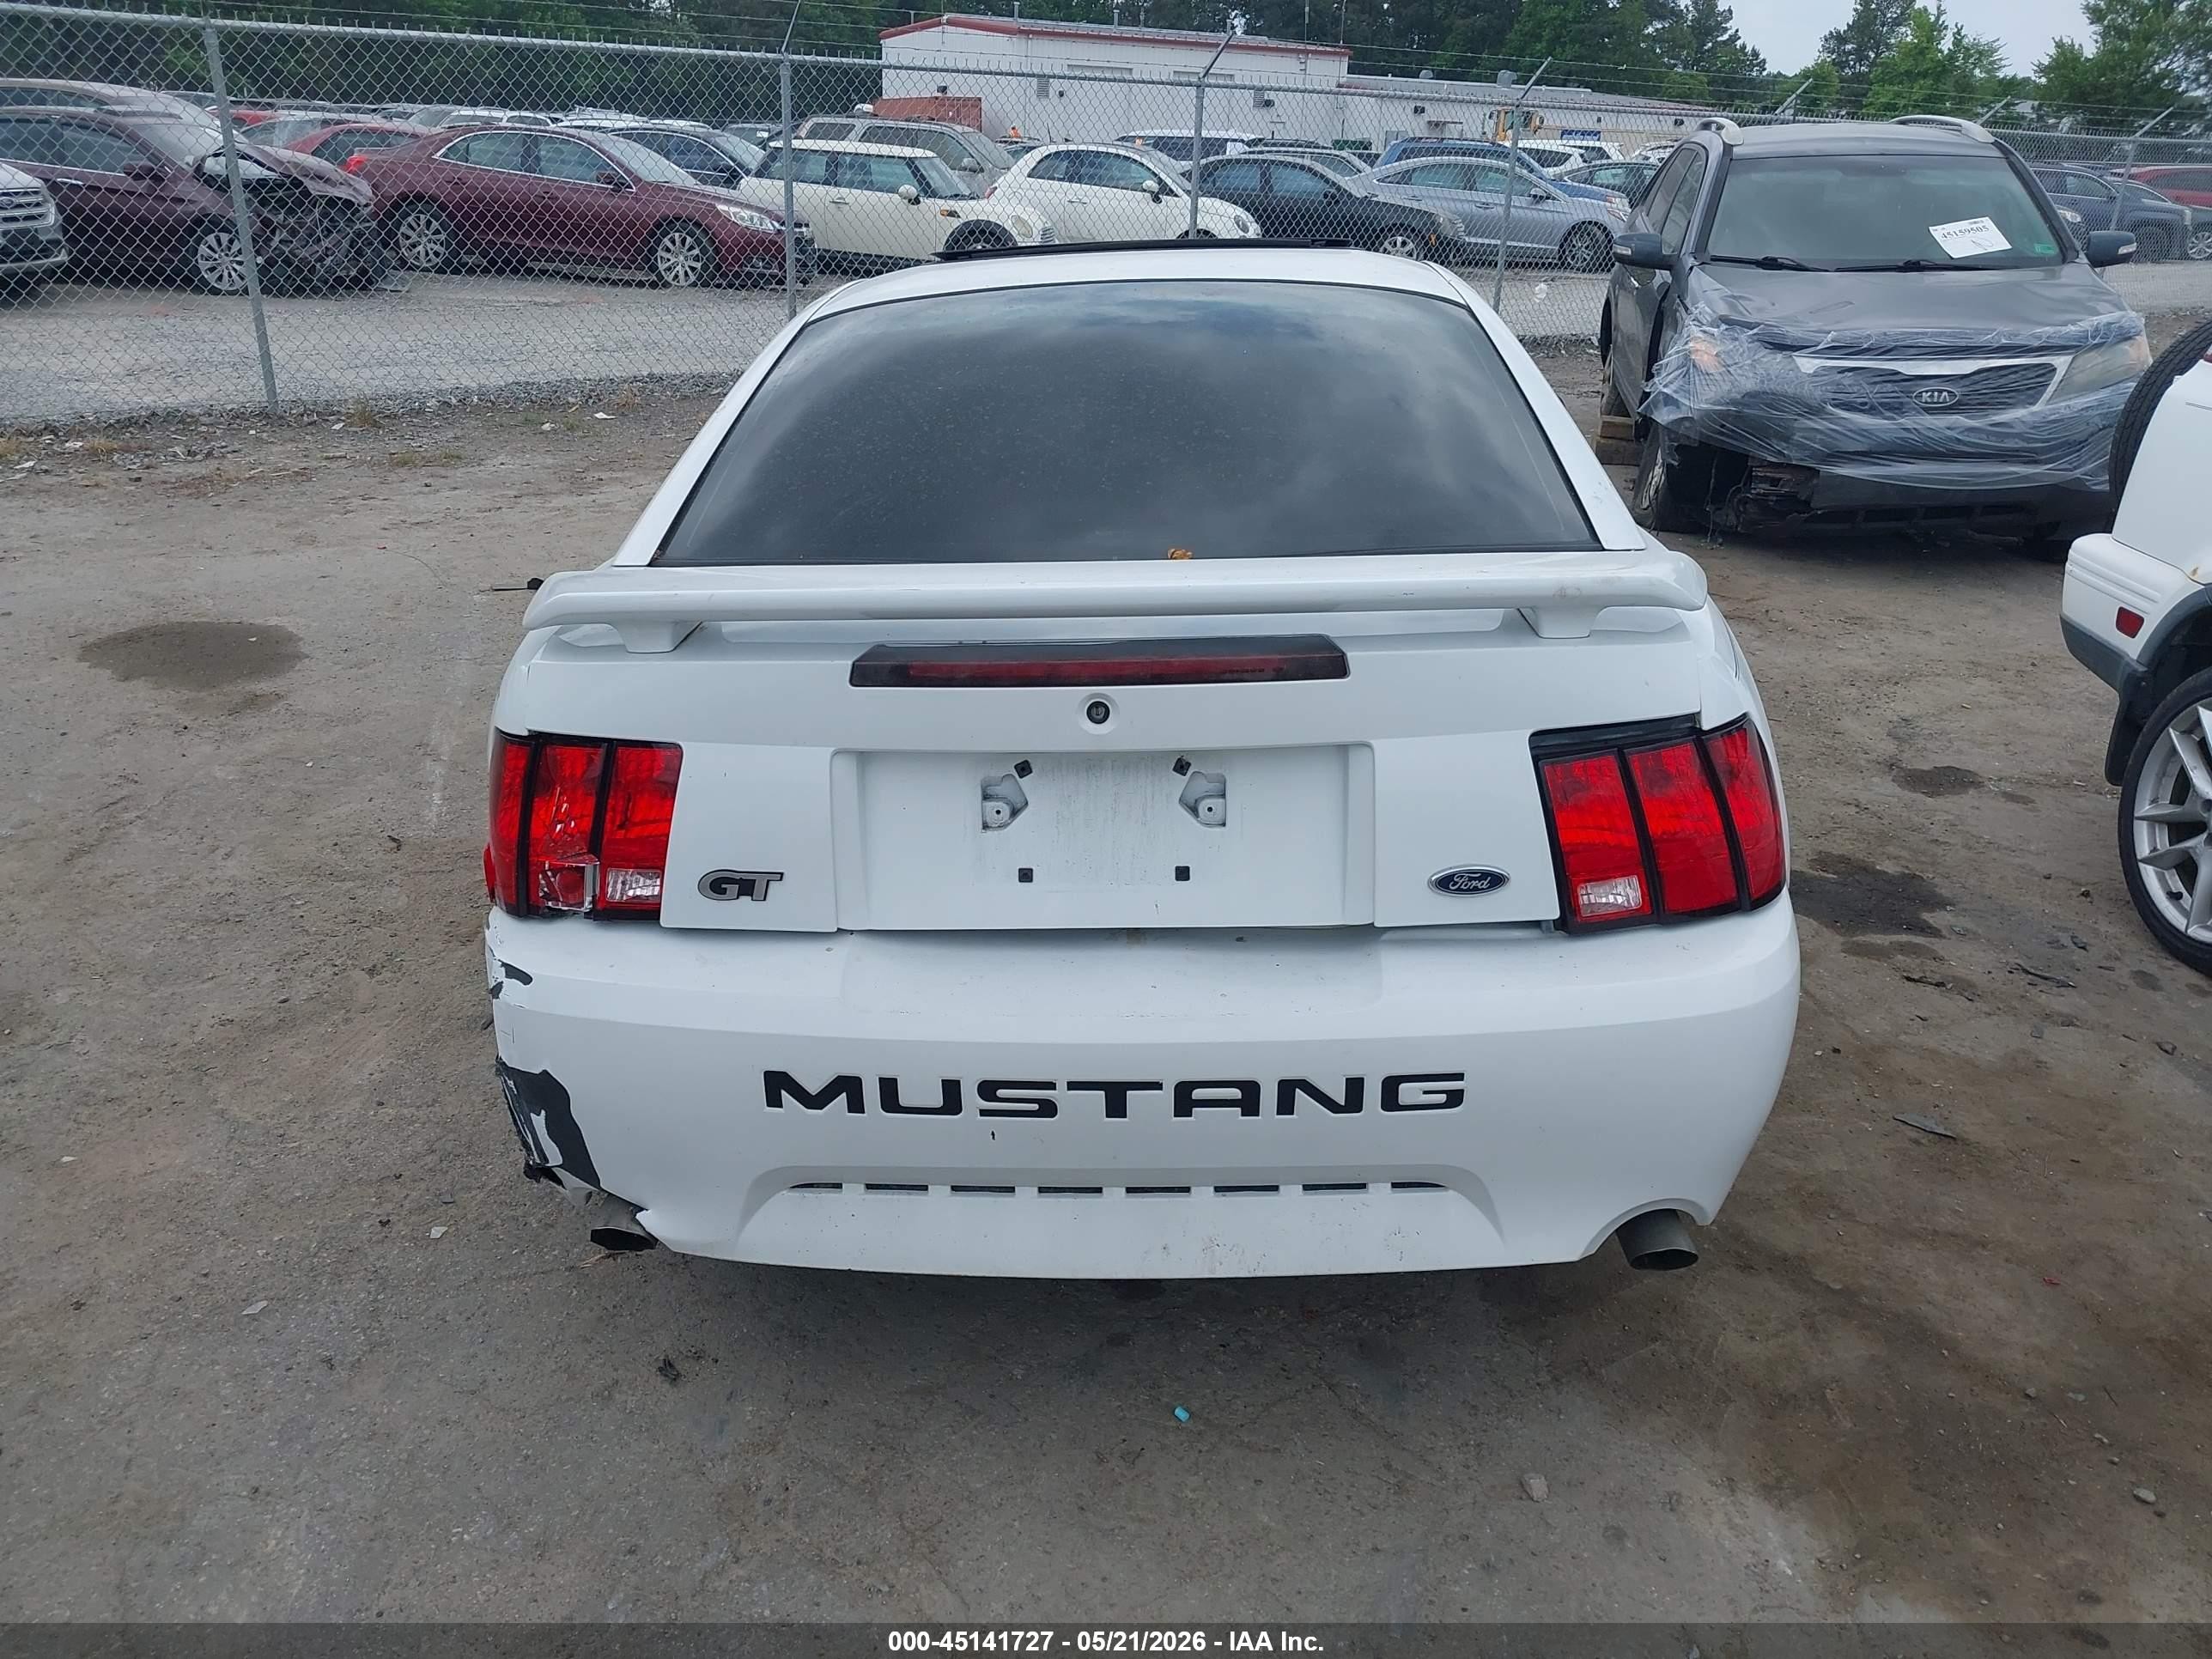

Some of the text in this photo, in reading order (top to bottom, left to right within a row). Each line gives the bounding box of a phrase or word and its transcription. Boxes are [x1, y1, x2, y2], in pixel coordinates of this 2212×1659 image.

[1942, 225, 1990, 240] 45159505
[1922, 391, 1950, 403] KIA
[697, 869, 784, 901] GT
[1449, 873, 1491, 890] Ford
[763, 1070, 1465, 1120] MUSTANG
